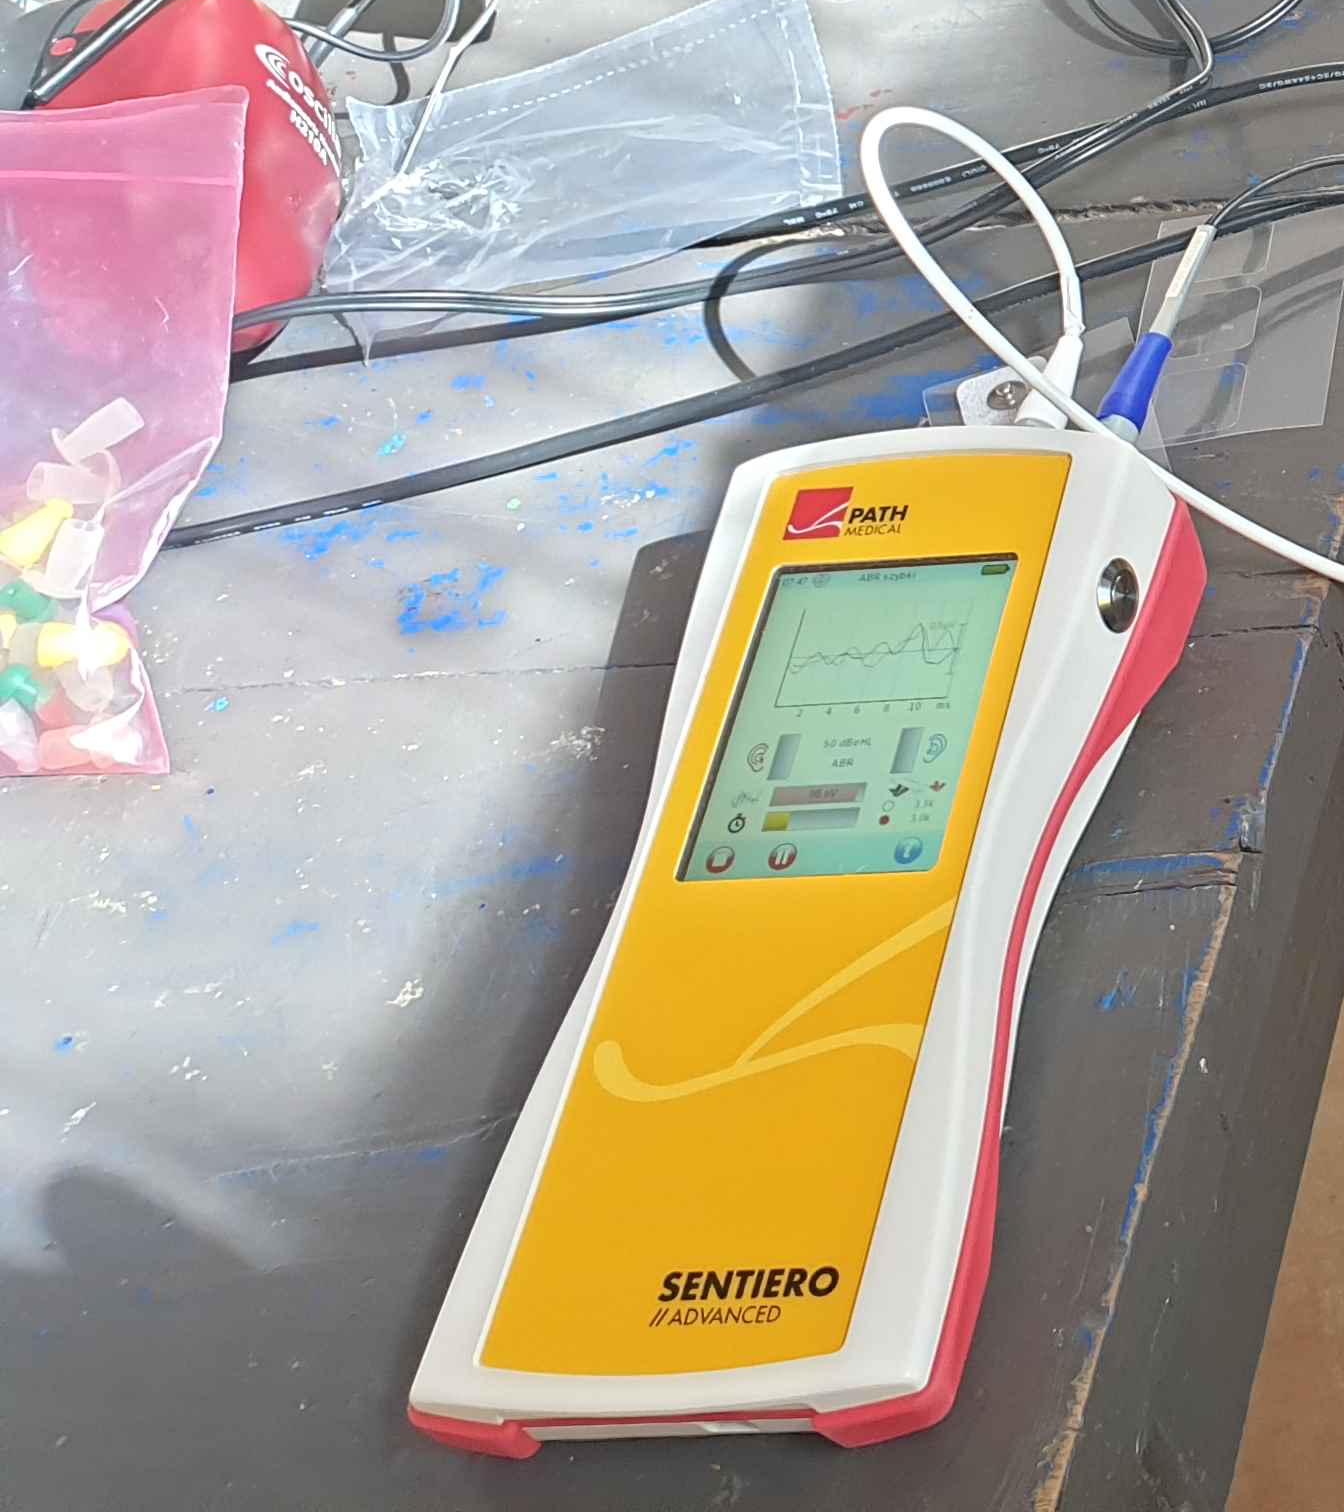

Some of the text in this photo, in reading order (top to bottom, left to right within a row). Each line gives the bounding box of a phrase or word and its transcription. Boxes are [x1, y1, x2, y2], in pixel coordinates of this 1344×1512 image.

[848, 504, 909, 524] PATH
[843, 523, 903, 537] MEDICAL
[658, 1266, 840, 1302] SENTIERO
